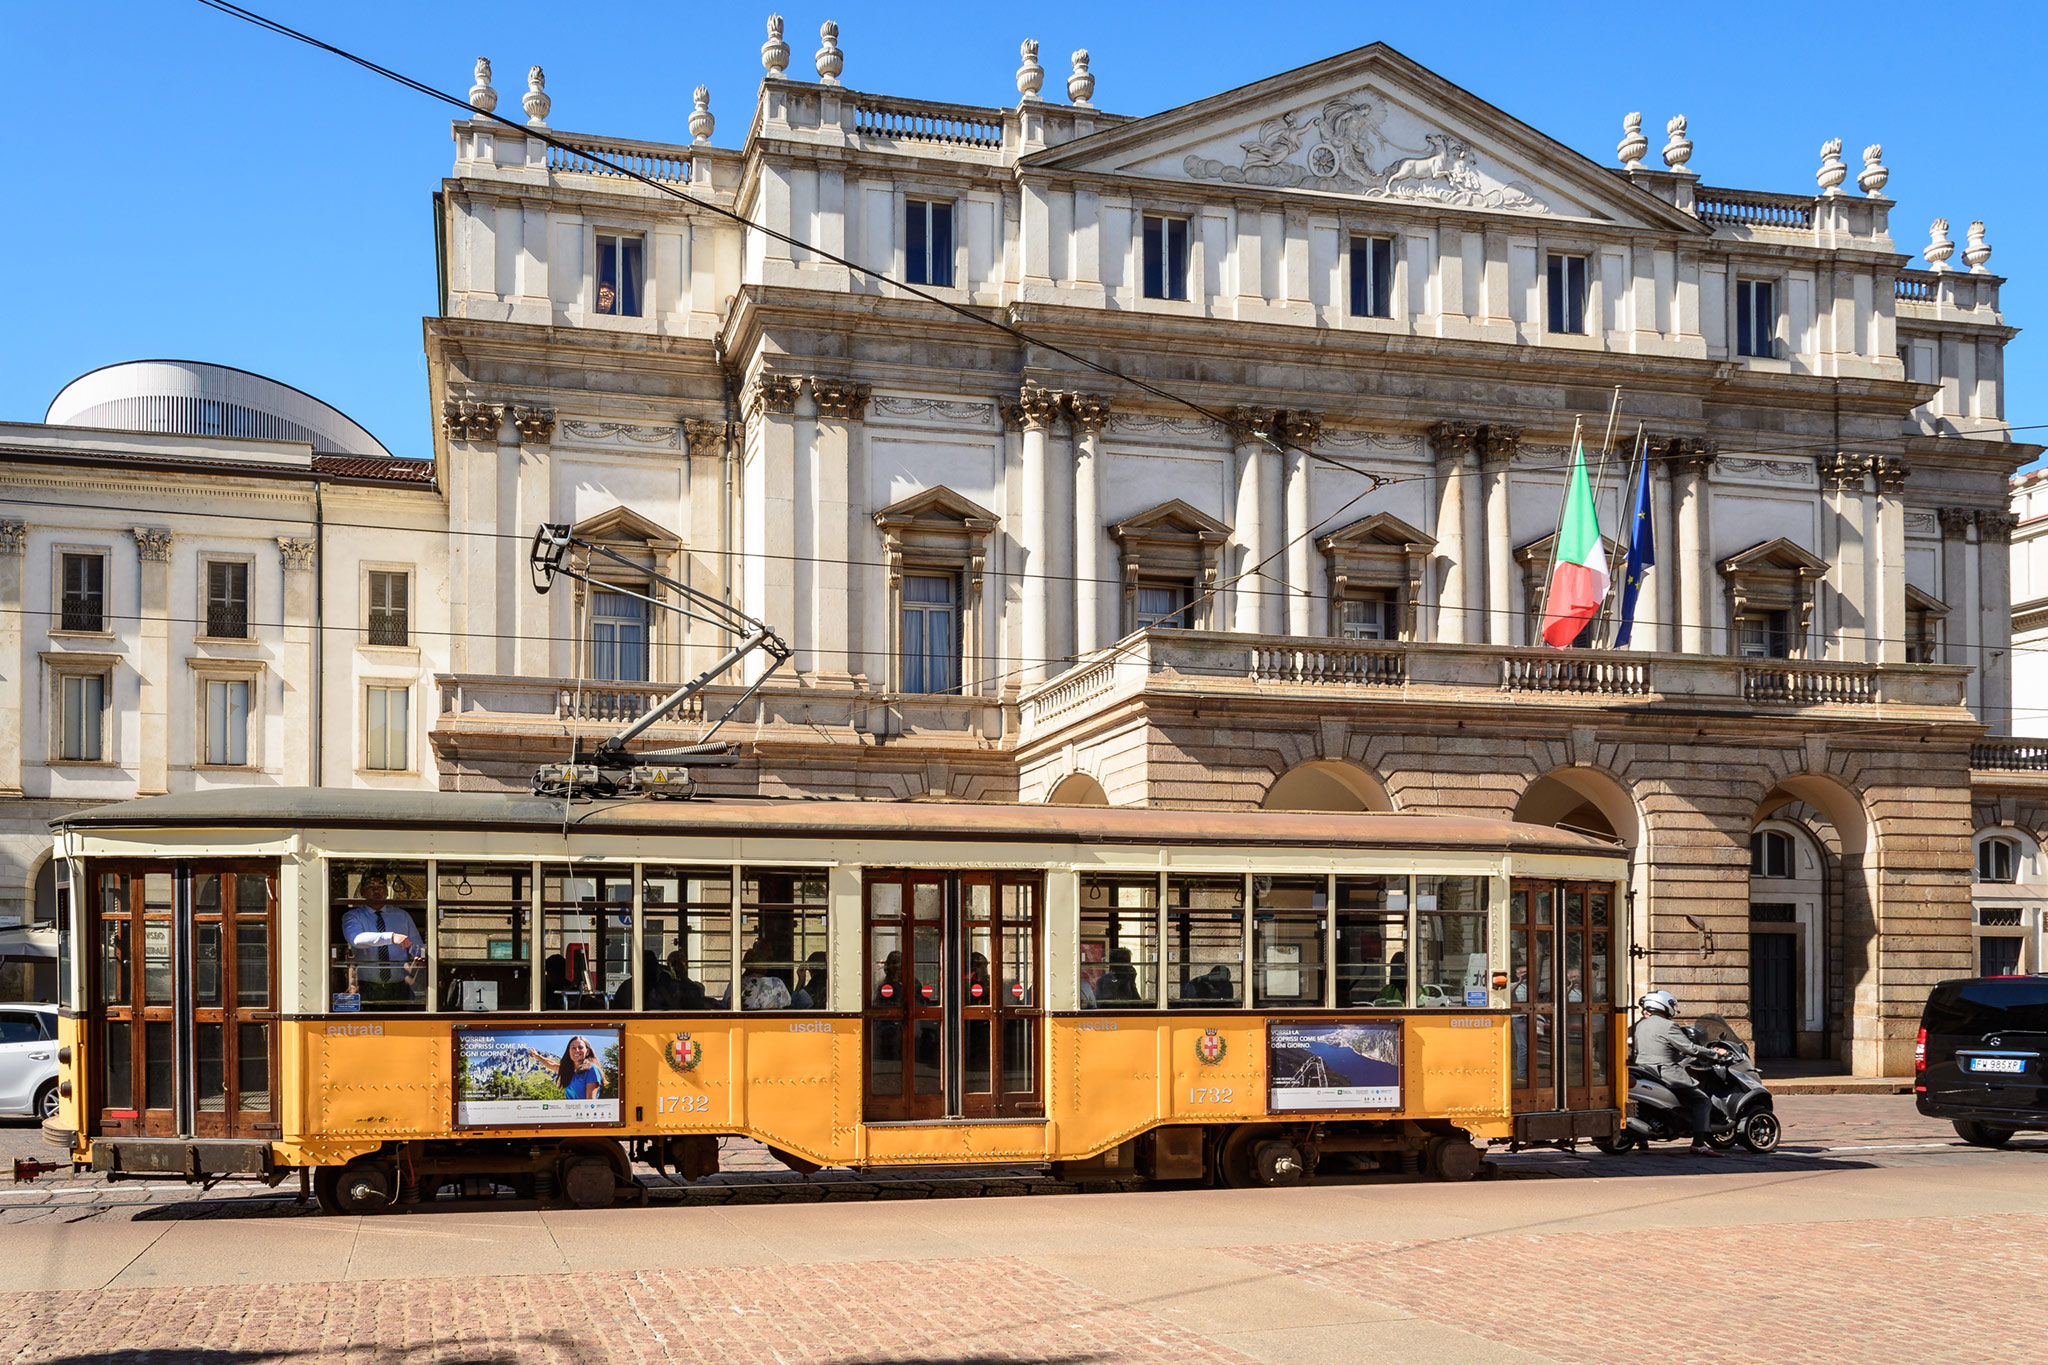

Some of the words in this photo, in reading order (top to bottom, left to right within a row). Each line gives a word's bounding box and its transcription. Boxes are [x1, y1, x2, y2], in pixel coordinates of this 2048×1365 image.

[475, 988, 484, 1004] 1
[789, 1020, 832, 1033] uscita
[1078, 1018, 1118, 1031] uscita
[1450, 1016, 1492, 1028] entrata
[327, 1023, 384, 1036] entrata
[1189, 1087, 1233, 1104] 1732
[658, 1095, 710, 1114] 1732
